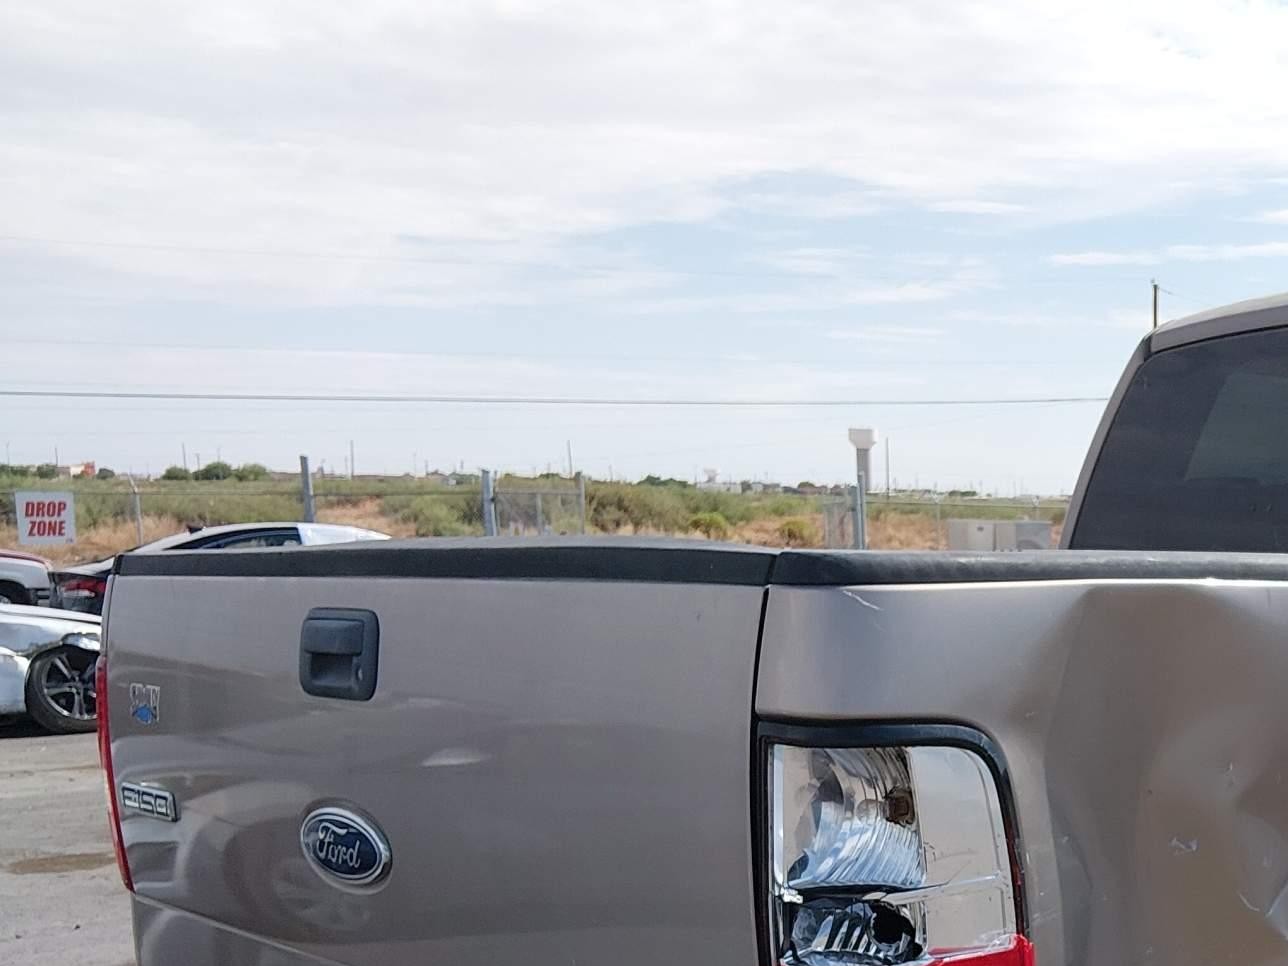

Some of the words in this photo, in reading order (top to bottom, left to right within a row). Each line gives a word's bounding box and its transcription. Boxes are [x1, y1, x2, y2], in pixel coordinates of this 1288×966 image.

[25, 501, 67, 517] DROP
[28, 520, 66, 537] ZONE
[316, 821, 361, 869] Ford
